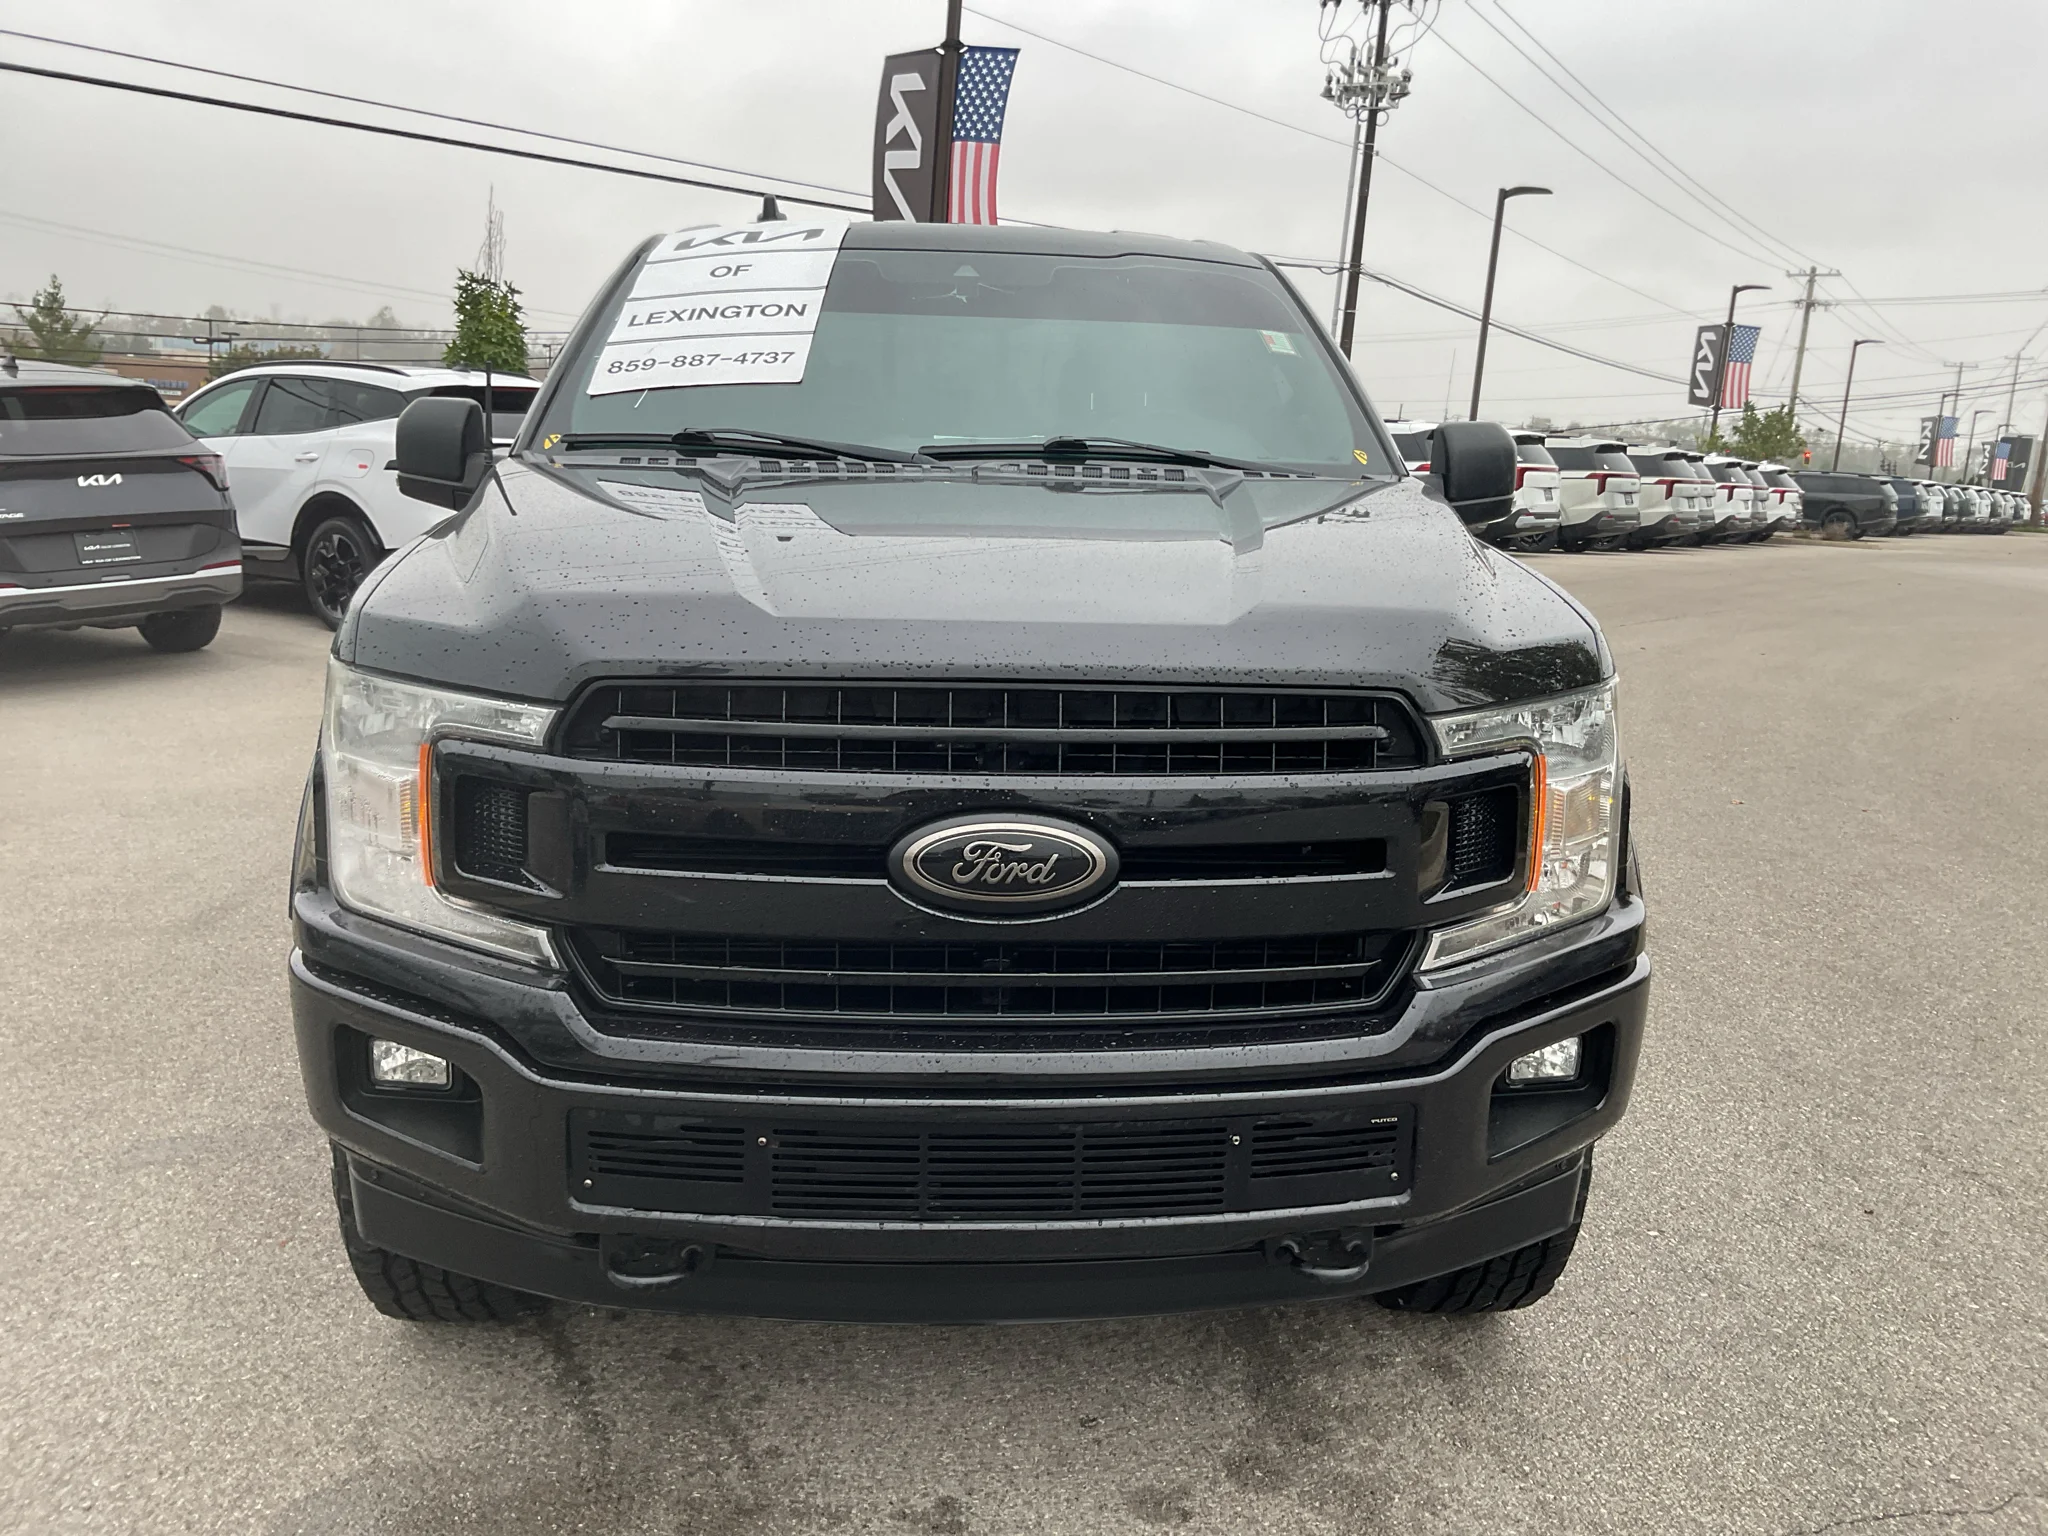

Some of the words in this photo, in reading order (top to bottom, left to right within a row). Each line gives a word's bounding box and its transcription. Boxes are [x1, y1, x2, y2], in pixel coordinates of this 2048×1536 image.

[673, 229, 825, 251] KIA
[709, 264, 752, 278] OF
[627, 303, 807, 328] LEXINGTON
[607, 351, 796, 374] 859-887-4737
[1693, 332, 1717, 398] KIA
[77, 473, 123, 487] KIA
[951, 840, 1059, 885] Ford
